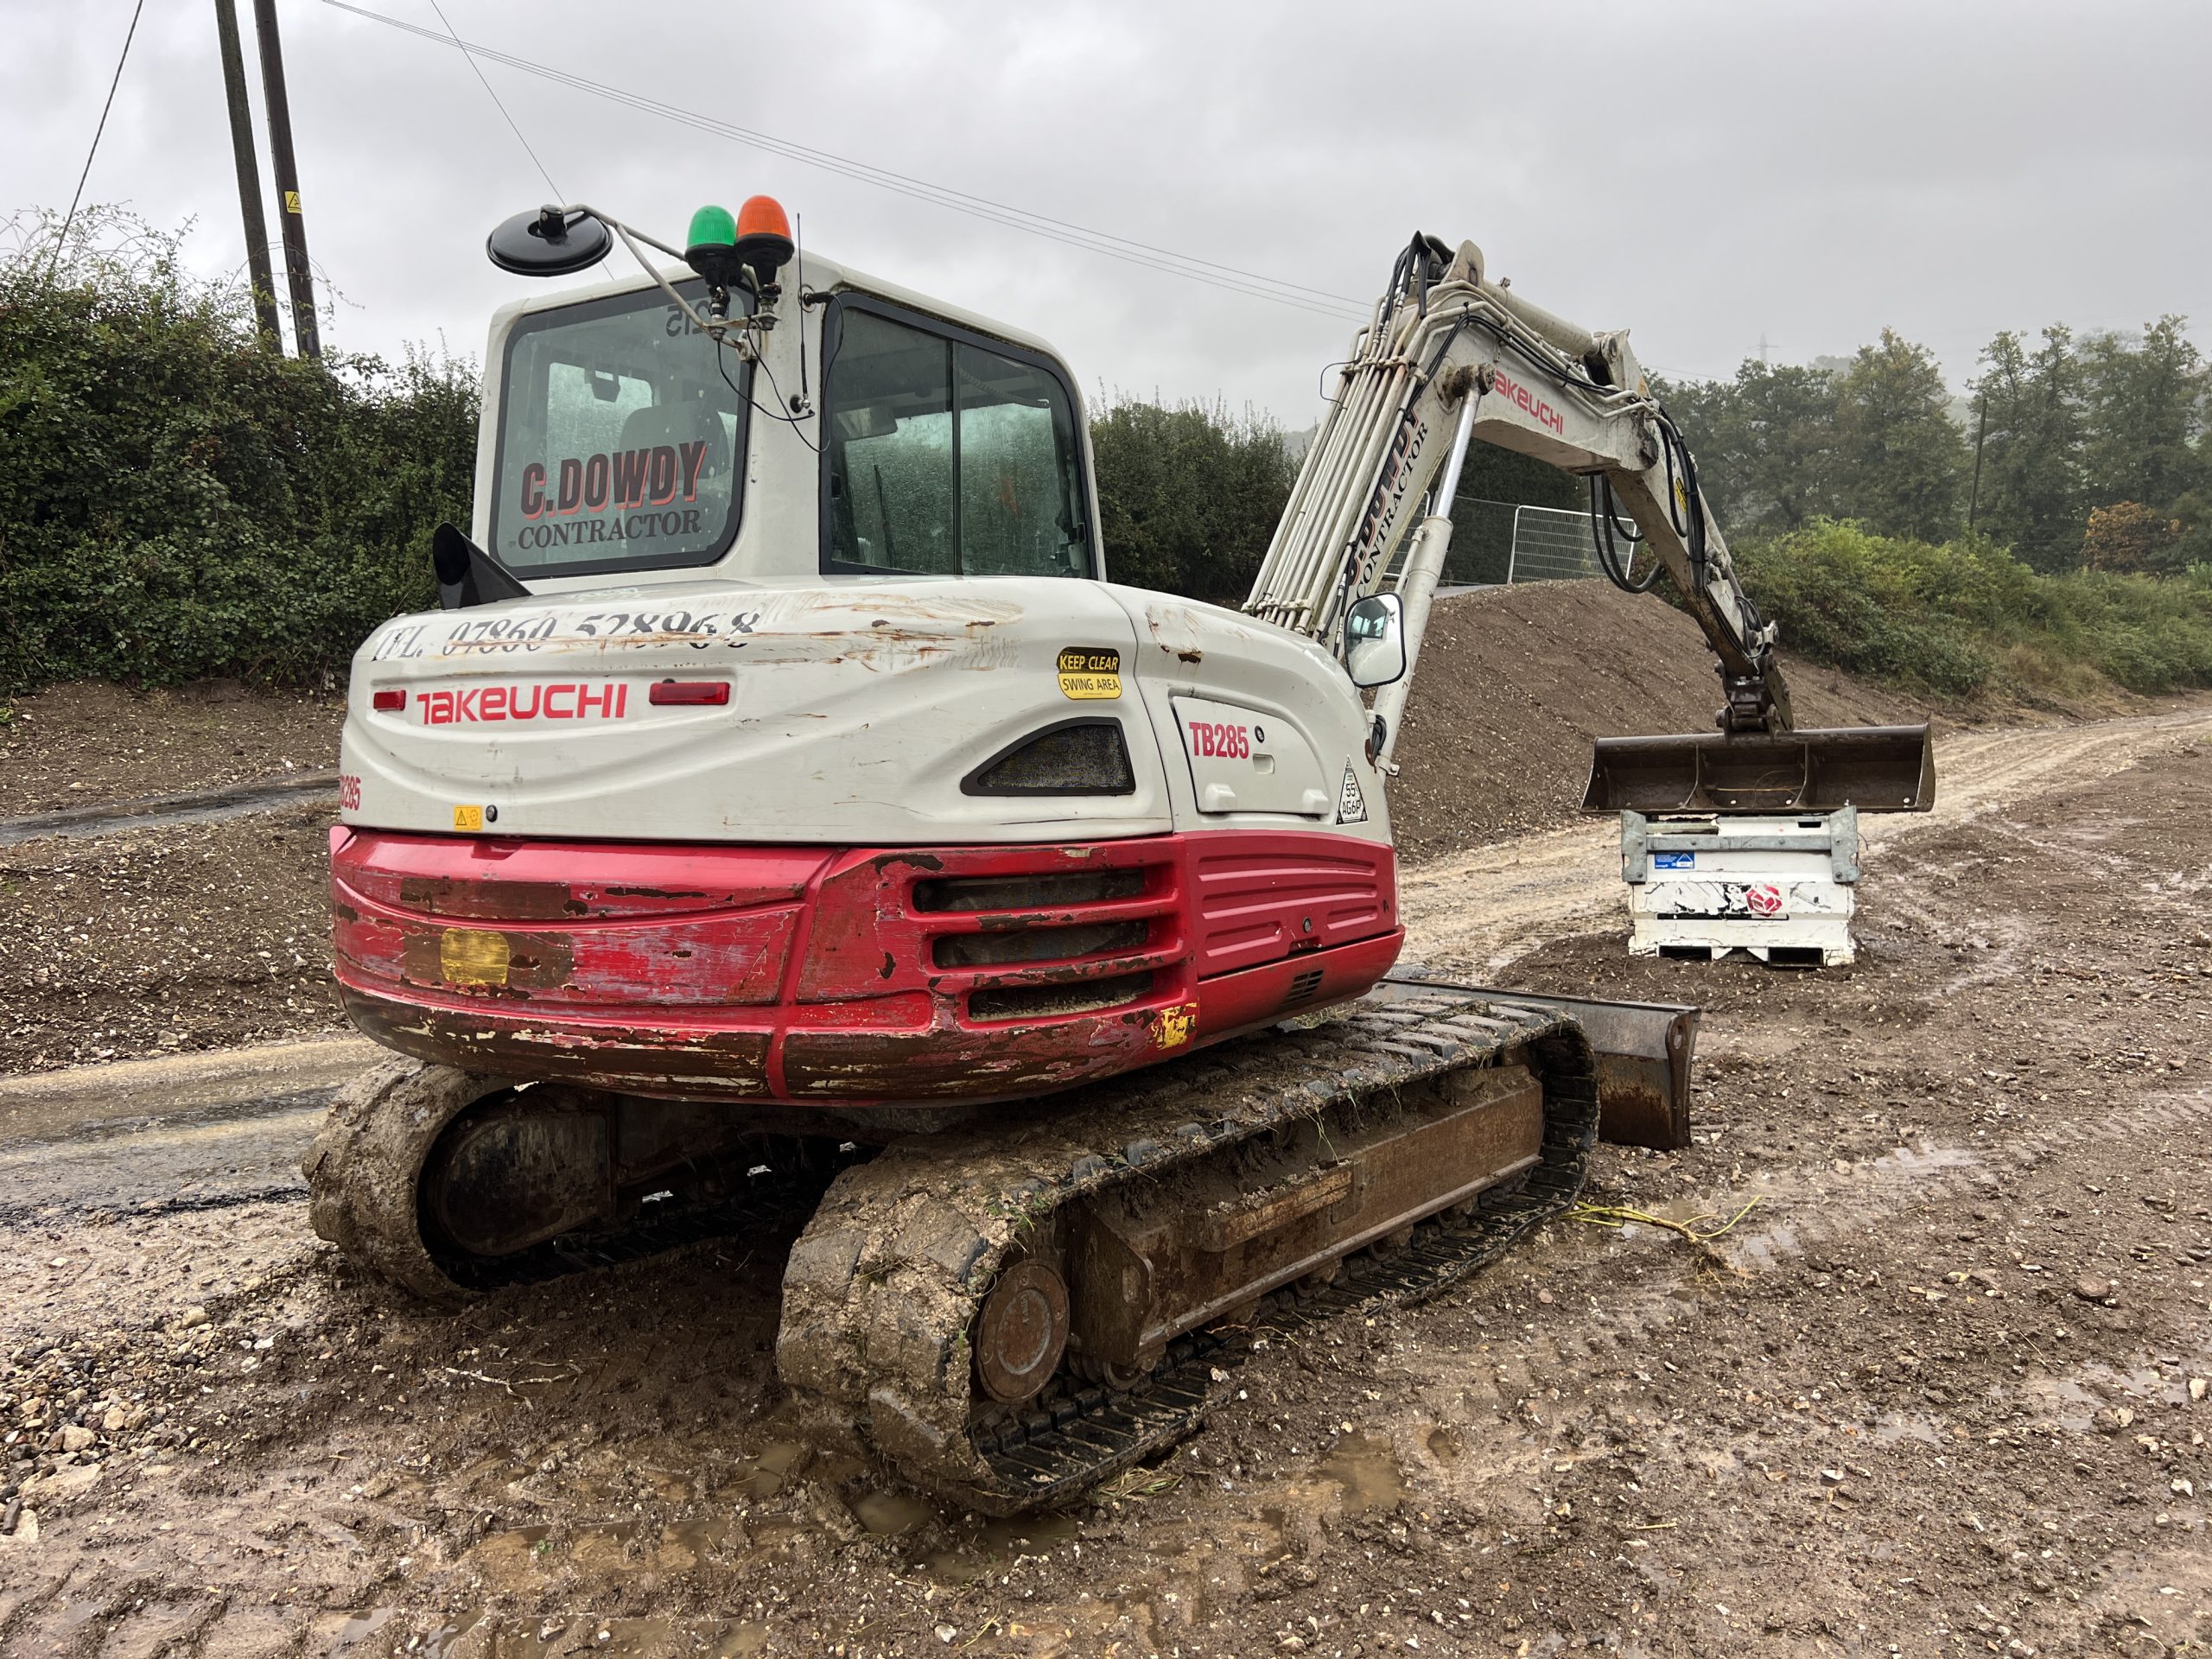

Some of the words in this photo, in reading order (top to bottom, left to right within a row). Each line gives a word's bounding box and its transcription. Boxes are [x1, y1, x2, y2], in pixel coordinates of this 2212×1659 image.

[1494, 370, 1564, 435] AKEUCHI
[520, 441, 708, 520] C.DOWDY
[518, 510, 702, 550] CONTRACTOR
[1356, 422, 1428, 600] CONTRACTOR
[442, 616, 558, 656] 07860
[1059, 655, 1086, 671] KEEP
[1089, 656, 1119, 671] CLEAR
[416, 683, 628, 725] TAKEUCHI
[1062, 678, 1094, 691] SWING
[1096, 678, 1121, 691] AREA
[1188, 721, 1249, 760] TB285
[1345, 783, 1356, 798] 55
